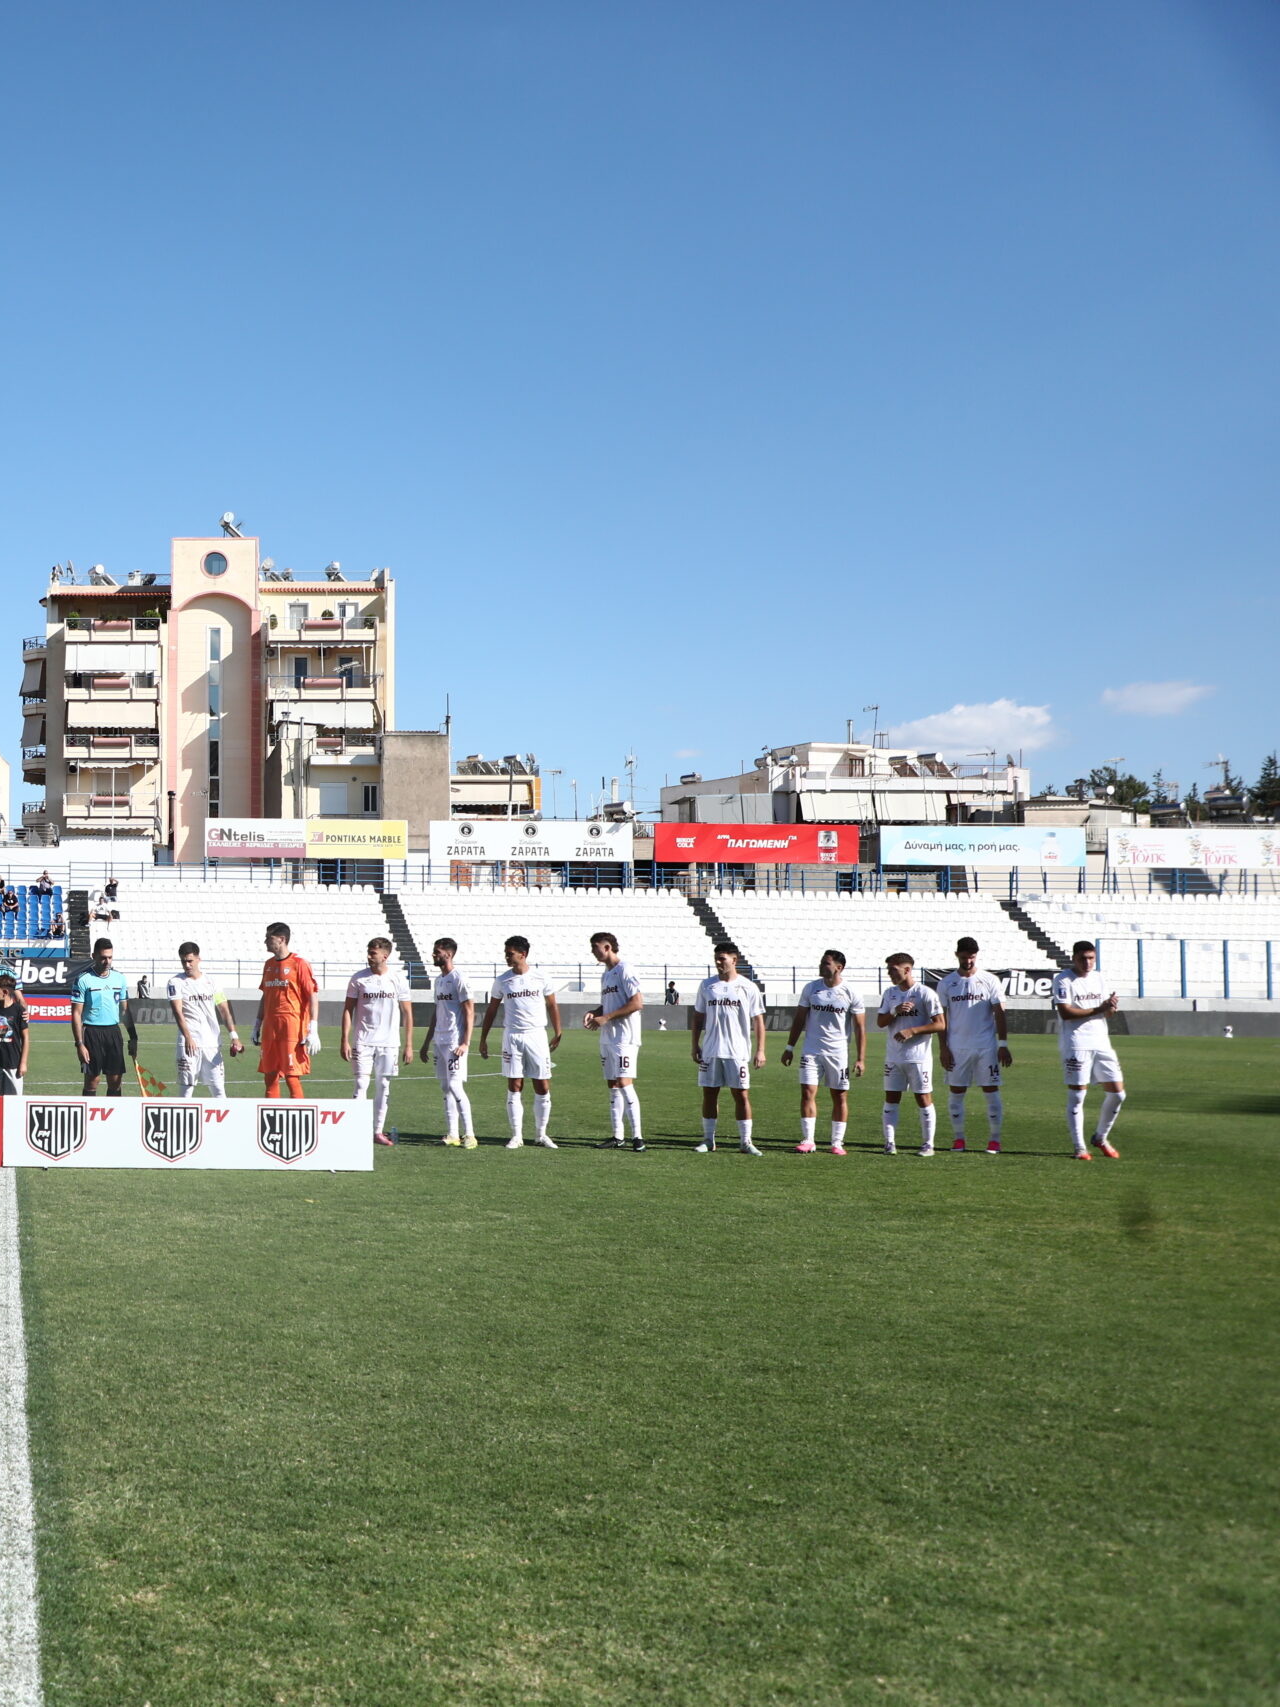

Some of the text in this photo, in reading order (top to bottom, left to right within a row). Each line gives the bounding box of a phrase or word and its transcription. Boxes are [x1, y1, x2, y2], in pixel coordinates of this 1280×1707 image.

[208, 828, 265, 841] GNtelis
[326, 834, 402, 843] PONTIKAS MARBLE
[727, 838, 789, 848] ΠΑΓΩΜΕΝΗ
[904, 841, 942, 851] Δύναμή
[968, 844, 975, 852] η
[977, 842, 997, 853] ροή
[447, 846, 486, 855] ZAPATA
[511, 846, 550, 856] ZAPATA
[575, 847, 614, 857] ZAPATA
[363, 990, 395, 999] novibet
[506, 989, 540, 999] novibet
[951, 992, 984, 1001] novibet
[708, 998, 741, 1007] novibet
[811, 1003, 846, 1014] novibet
[448, 1058, 460, 1071] 28
[619, 1056, 630, 1069] 16
[740, 1066, 746, 1079] 6
[988, 1065, 999, 1077] 14
[922, 1071, 929, 1083] 3
[89, 1108, 114, 1121] TV
[204, 1109, 230, 1122] TV
[320, 1111, 345, 1124] TV
[37, 1130, 51, 1138] FM
[269, 1133, 283, 1141] FM
